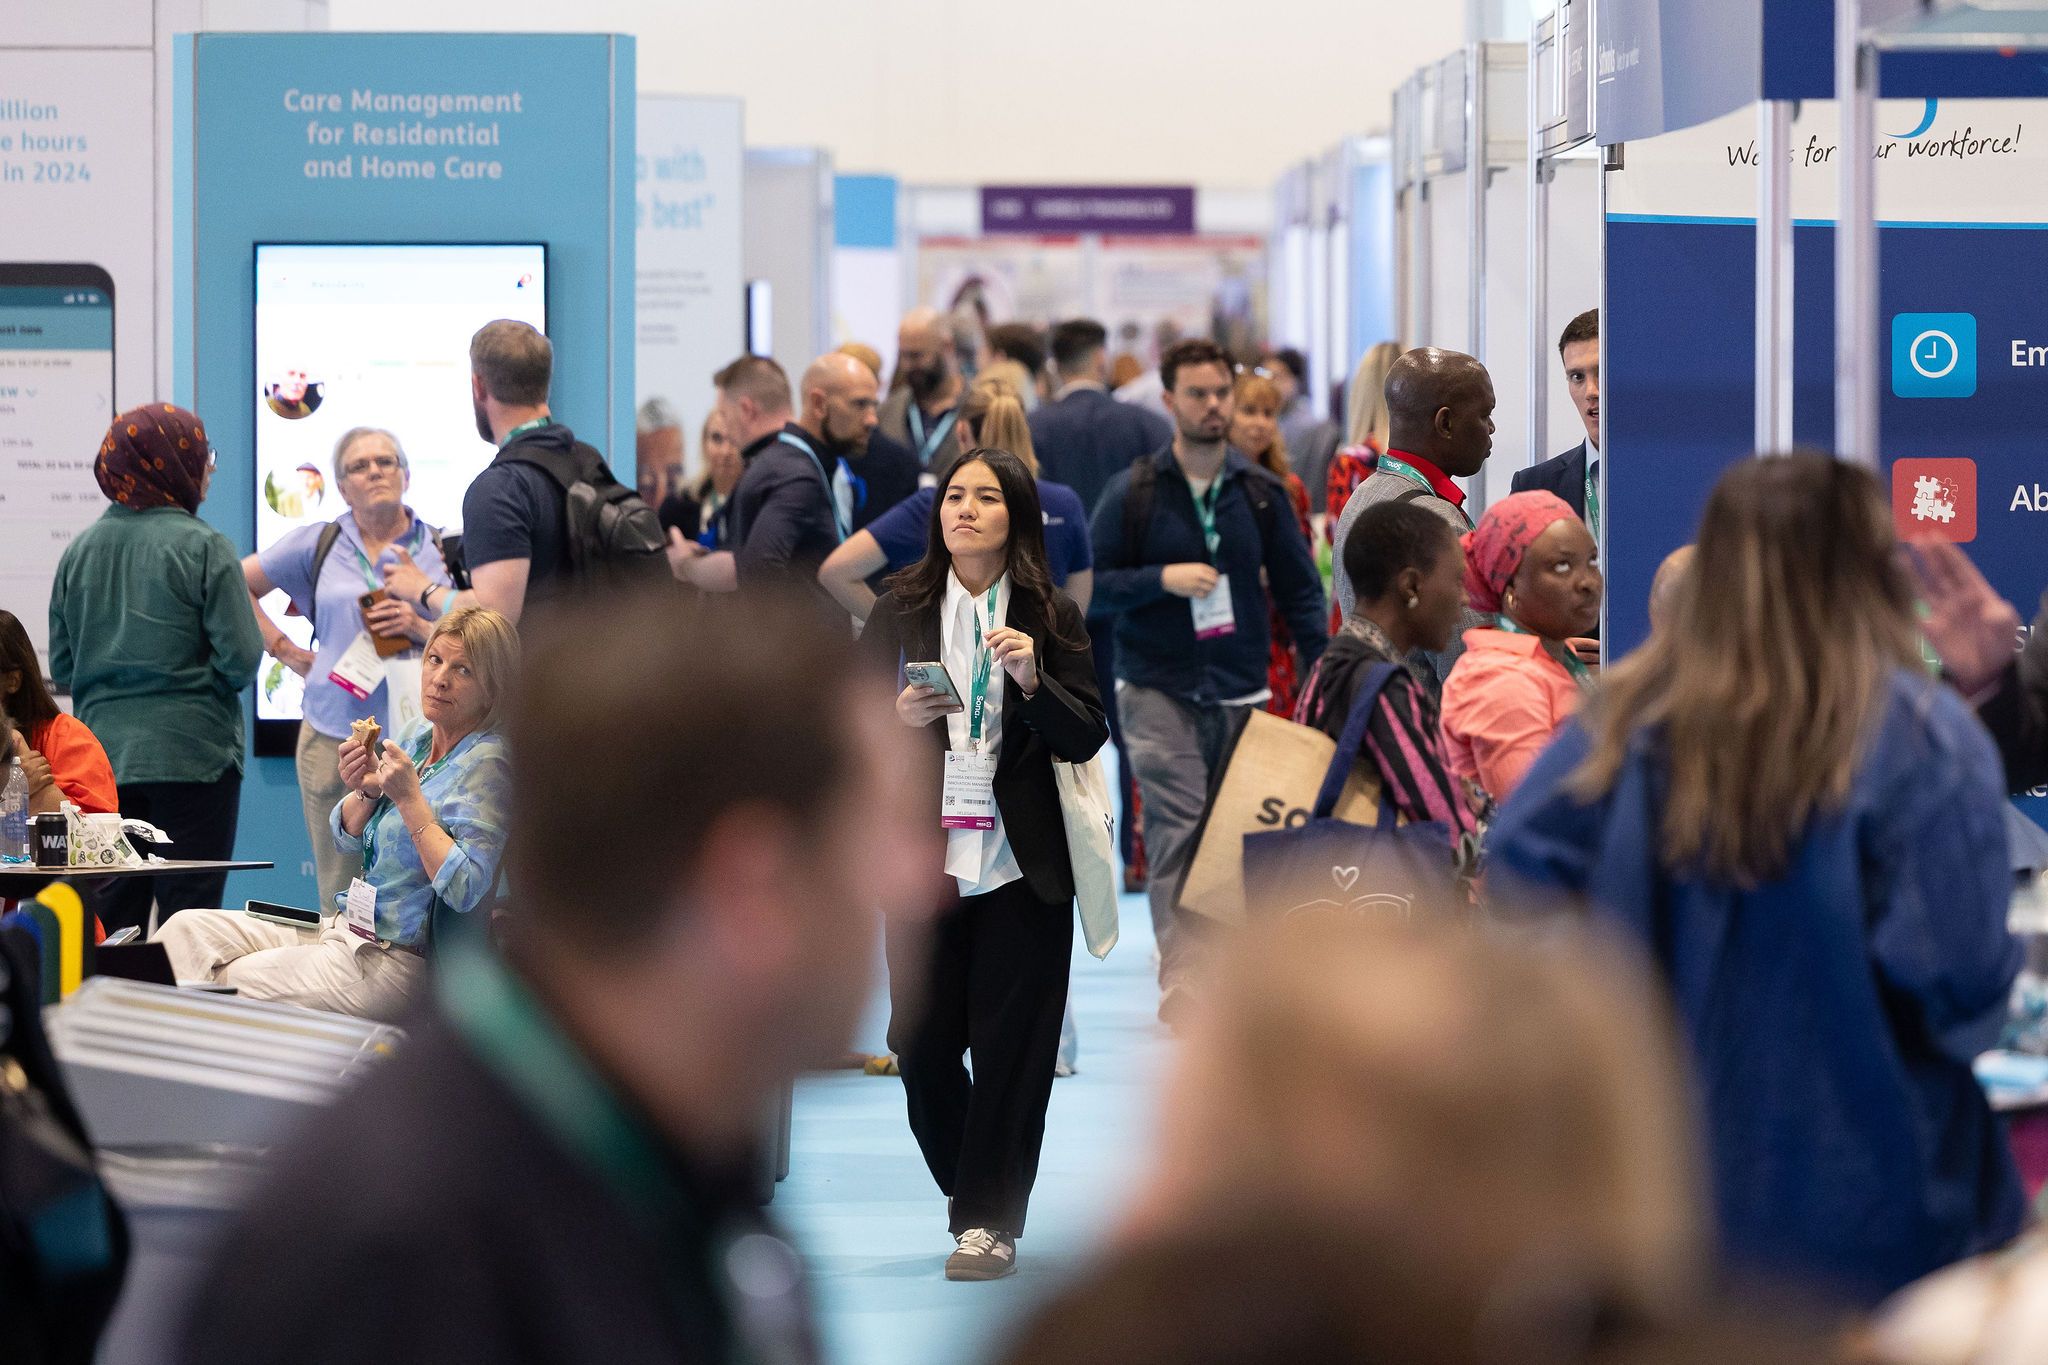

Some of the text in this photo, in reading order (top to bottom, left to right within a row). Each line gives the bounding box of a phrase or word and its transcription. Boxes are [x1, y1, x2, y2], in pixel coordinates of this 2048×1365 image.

[283, 89, 523, 118] Care Management
[21, 129, 88, 152] hours
[307, 120, 500, 145] for Residential
[1805, 134, 1838, 167] for
[1908, 123, 2023, 160] workforce!
[3, 160, 92, 184] in 2024
[303, 155, 503, 179] and Home Care
[973, 694, 985, 719] Sona.
[41, 835, 68, 849] WA
